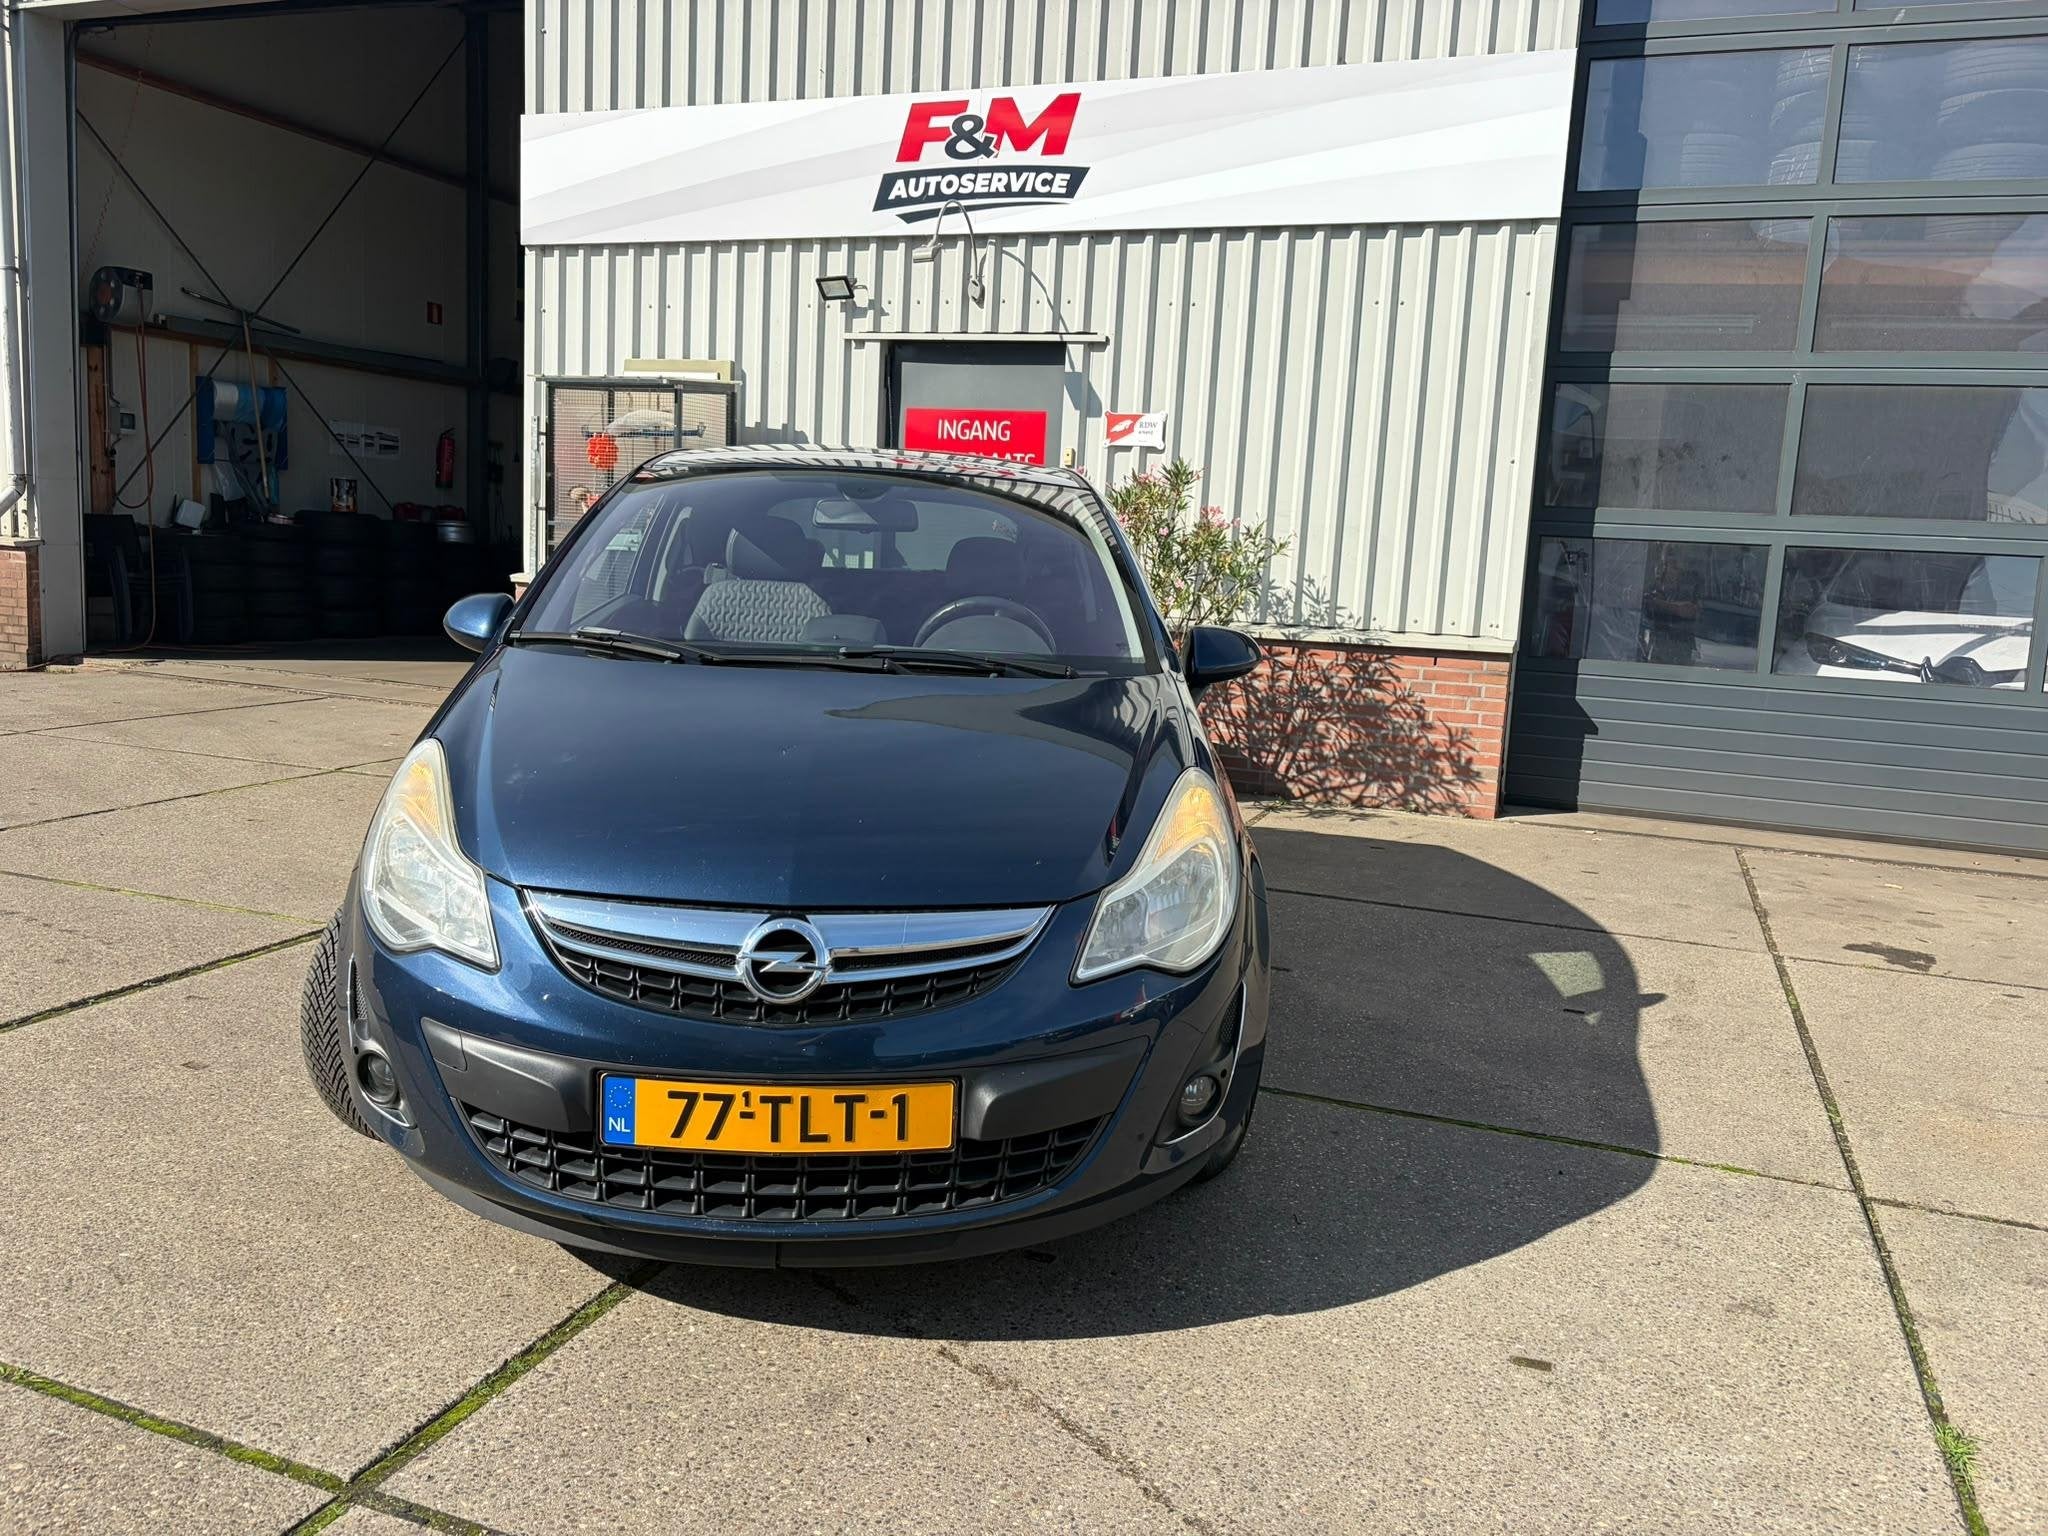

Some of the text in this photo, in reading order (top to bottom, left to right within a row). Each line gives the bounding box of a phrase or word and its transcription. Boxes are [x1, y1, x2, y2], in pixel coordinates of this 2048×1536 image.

[896, 92, 1082, 162] F&M
[888, 171, 1071, 201] AUTOSERVICE
[937, 419, 1011, 441] INGANG
[608, 1117, 631, 1133] NL
